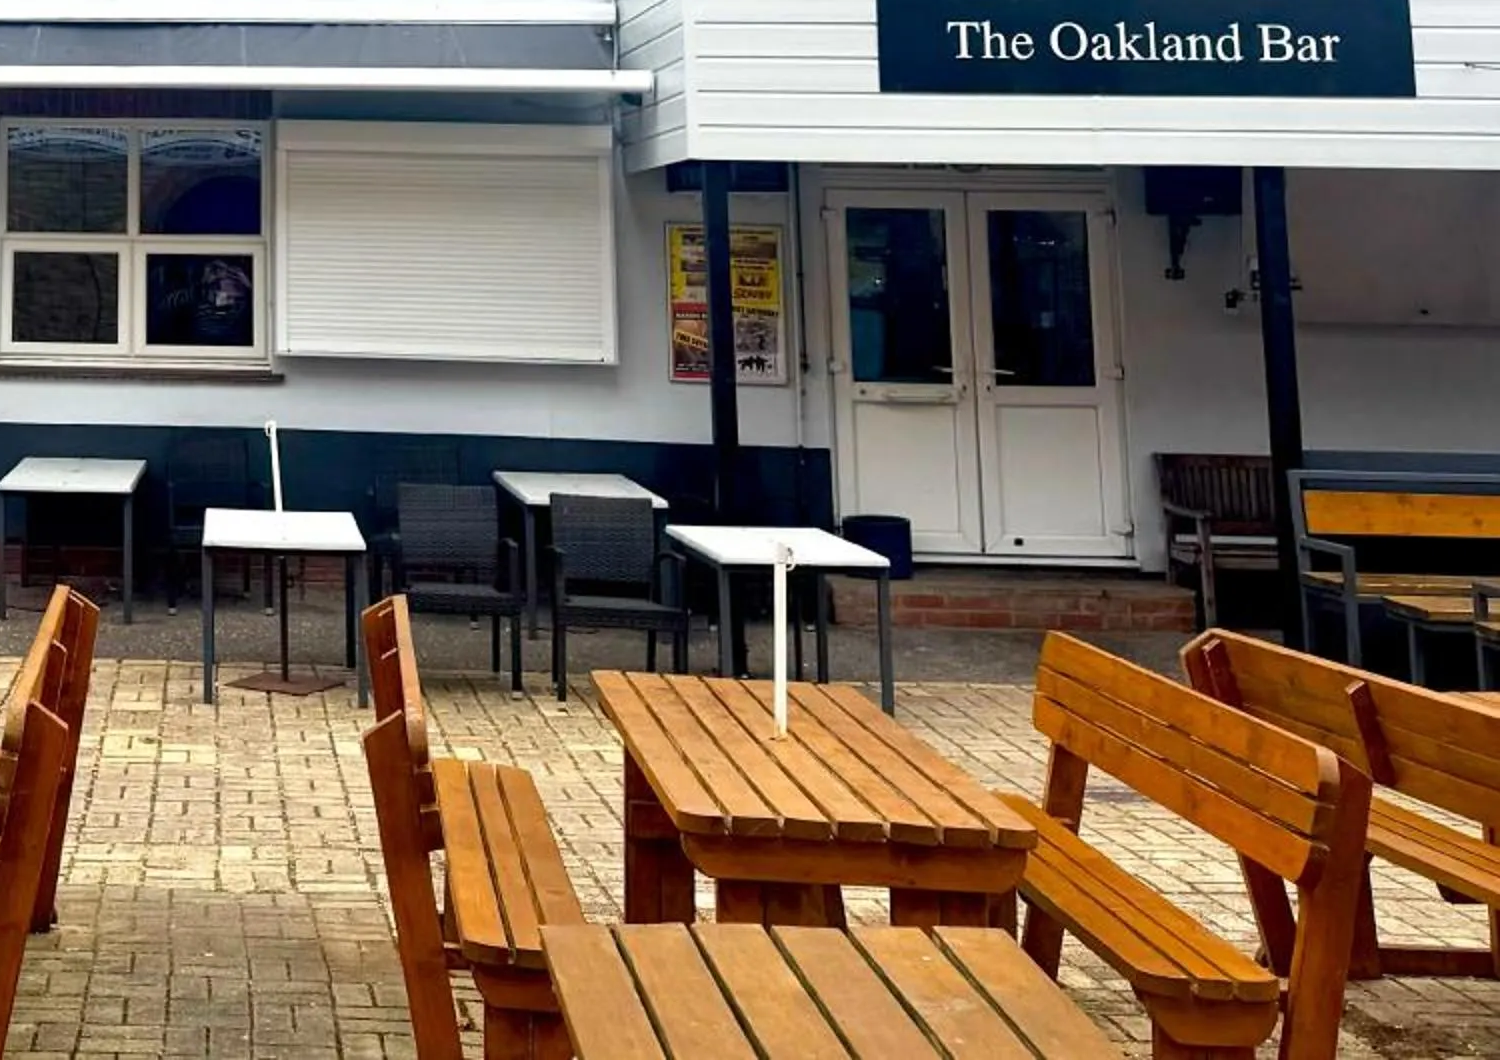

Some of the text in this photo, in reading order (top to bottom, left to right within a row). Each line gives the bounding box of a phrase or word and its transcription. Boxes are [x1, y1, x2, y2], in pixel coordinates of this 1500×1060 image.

[946, 19, 1342, 63] The Oakland Bar
